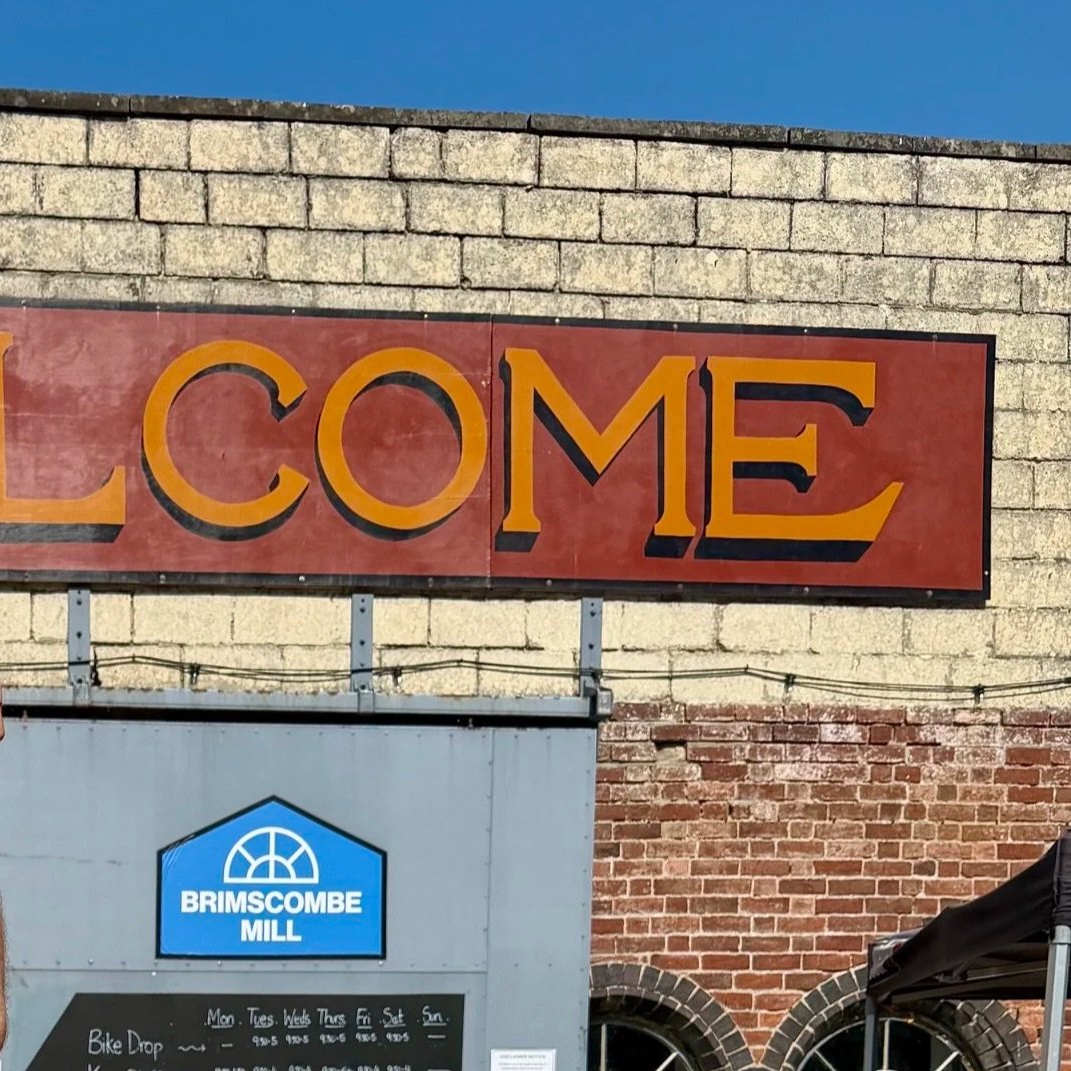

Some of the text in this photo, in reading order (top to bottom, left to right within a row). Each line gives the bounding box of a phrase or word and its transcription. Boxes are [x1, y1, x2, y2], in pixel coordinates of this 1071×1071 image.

[180, 890, 363, 914] BRIMSCOMBE
[240, 919, 302, 942] MILL
[355, 1007, 373, 1030] Fri
[88, 1028, 123, 1055] Bike
[127, 1029, 163, 1061] Drop
